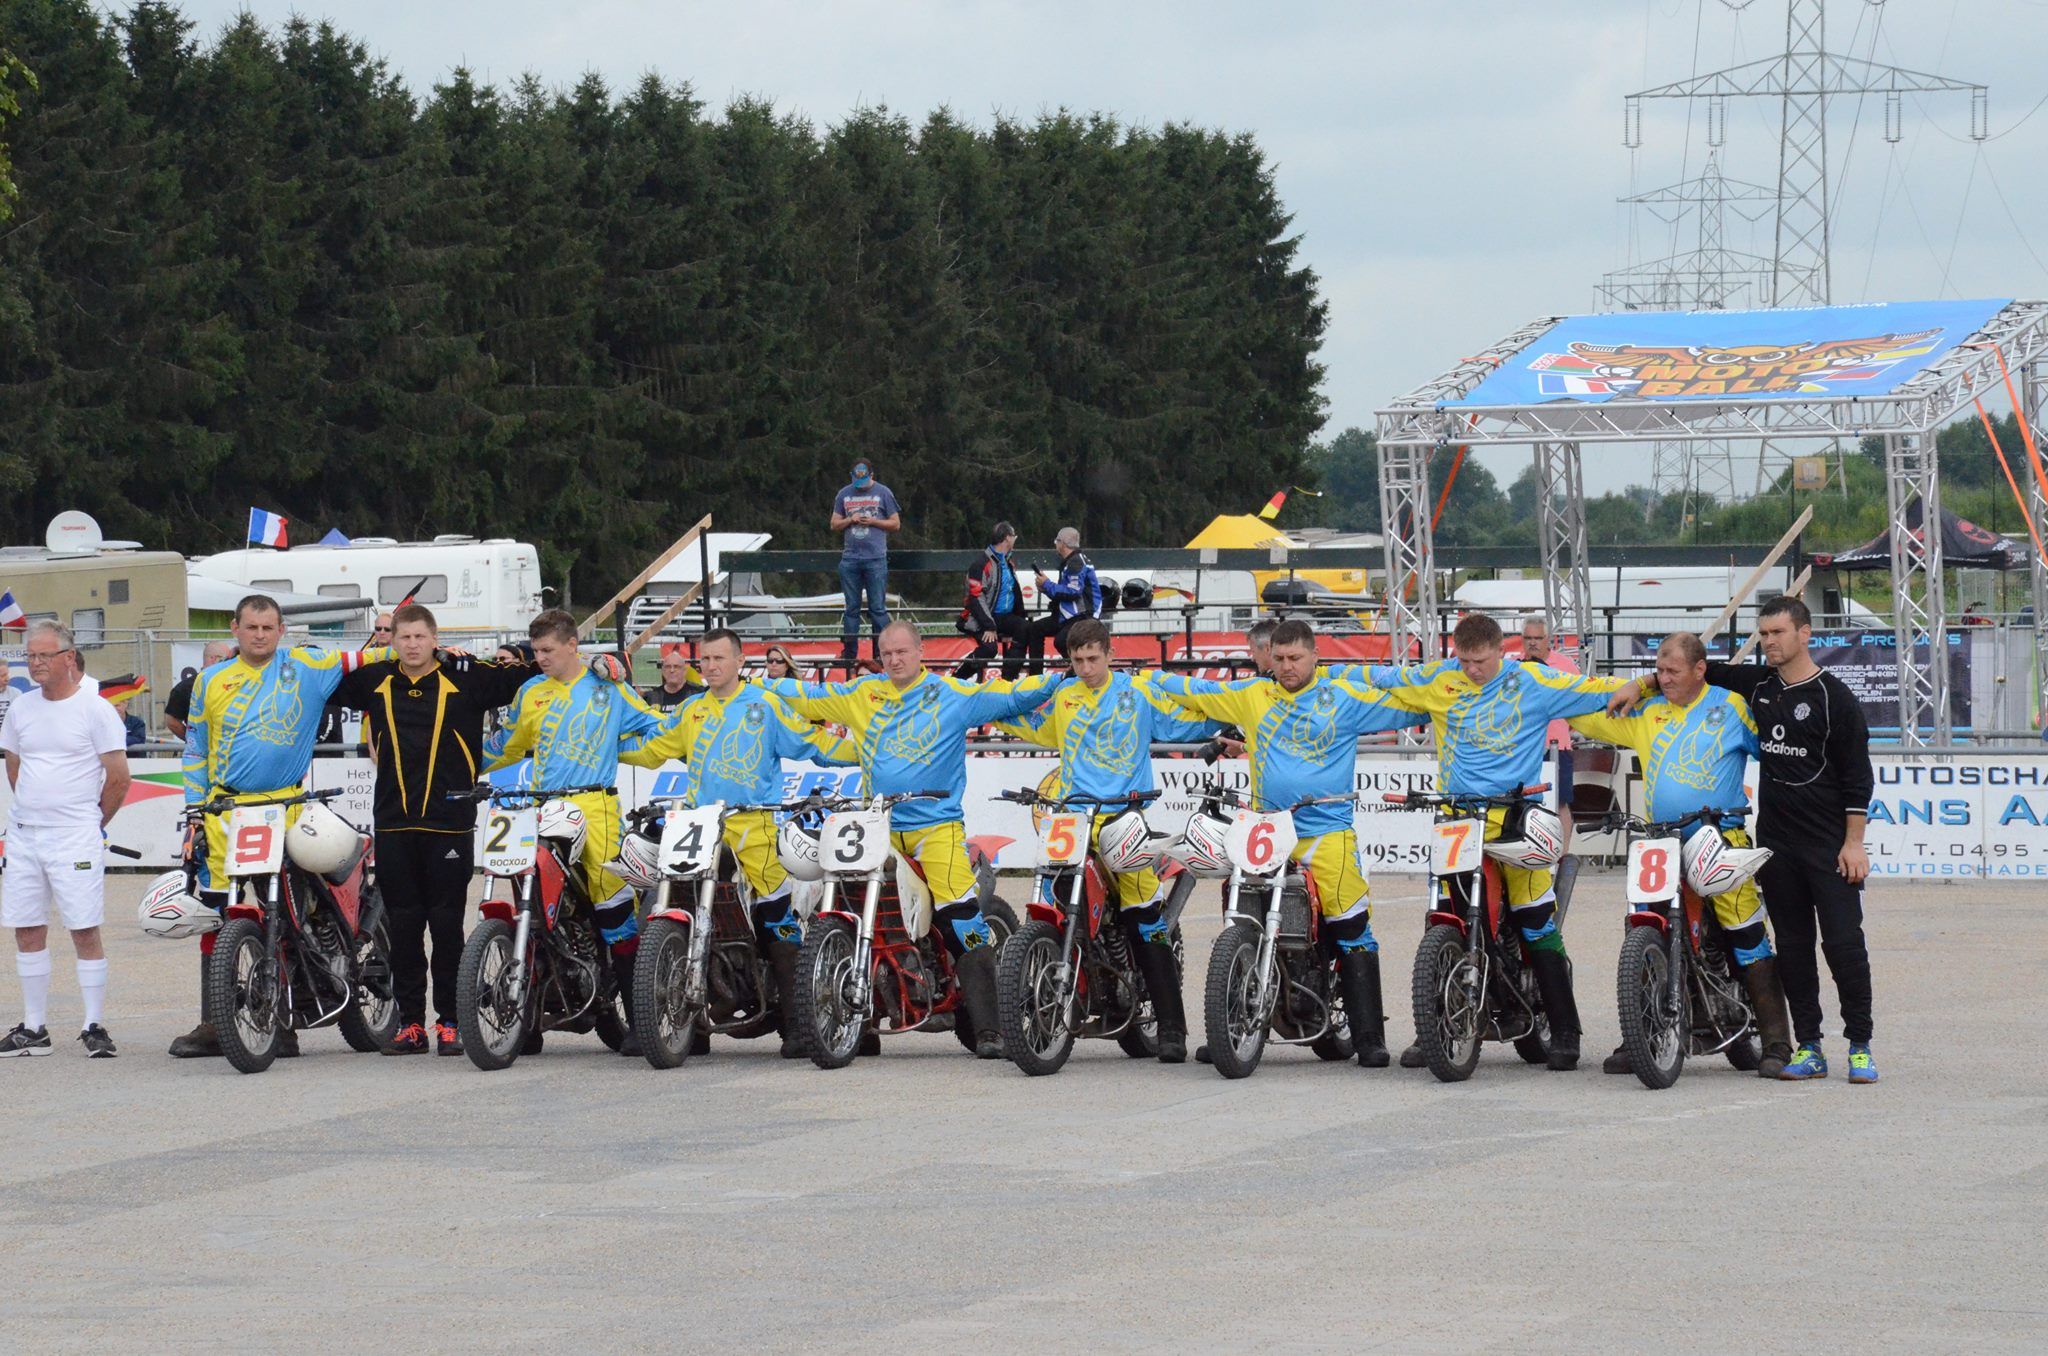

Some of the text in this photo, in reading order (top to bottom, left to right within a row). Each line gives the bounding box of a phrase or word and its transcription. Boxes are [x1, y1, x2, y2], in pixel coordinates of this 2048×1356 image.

[1635, 359, 1829, 380] MOTO
[1637, 376, 1797, 395] BALL
[347, 770, 372, 779] Het
[1160, 771, 1440, 791] WORLD DUSTR
[1880, 766, 2048, 785] UTOSCH
[347, 785, 372, 795] 602
[349, 800, 371, 810] Tel:
[1164, 802, 1195, 812] voor
[1999, 795, 2048, 826] A
[235, 825, 273, 863] 9
[485, 815, 512, 852] 2
[672, 822, 704, 859] 4
[835, 822, 866, 863] 3
[1046, 817, 1077, 860] 5
[1125, 827, 1144, 851] MOTS
[1190, 829, 1209, 852] MOTS
[1246, 822, 1276, 866] 6
[1528, 826, 1550, 848] MOTS
[1441, 825, 1471, 868] 7
[1701, 839, 1719, 864] MOTS
[1914, 843, 1935, 855] T.
[1950, 843, 2029, 857] 0495
[489, 858, 527, 867] ВОСХОД
[1638, 848, 1668, 894] 8
[1870, 863, 2047, 875] AUTOSCHADE
